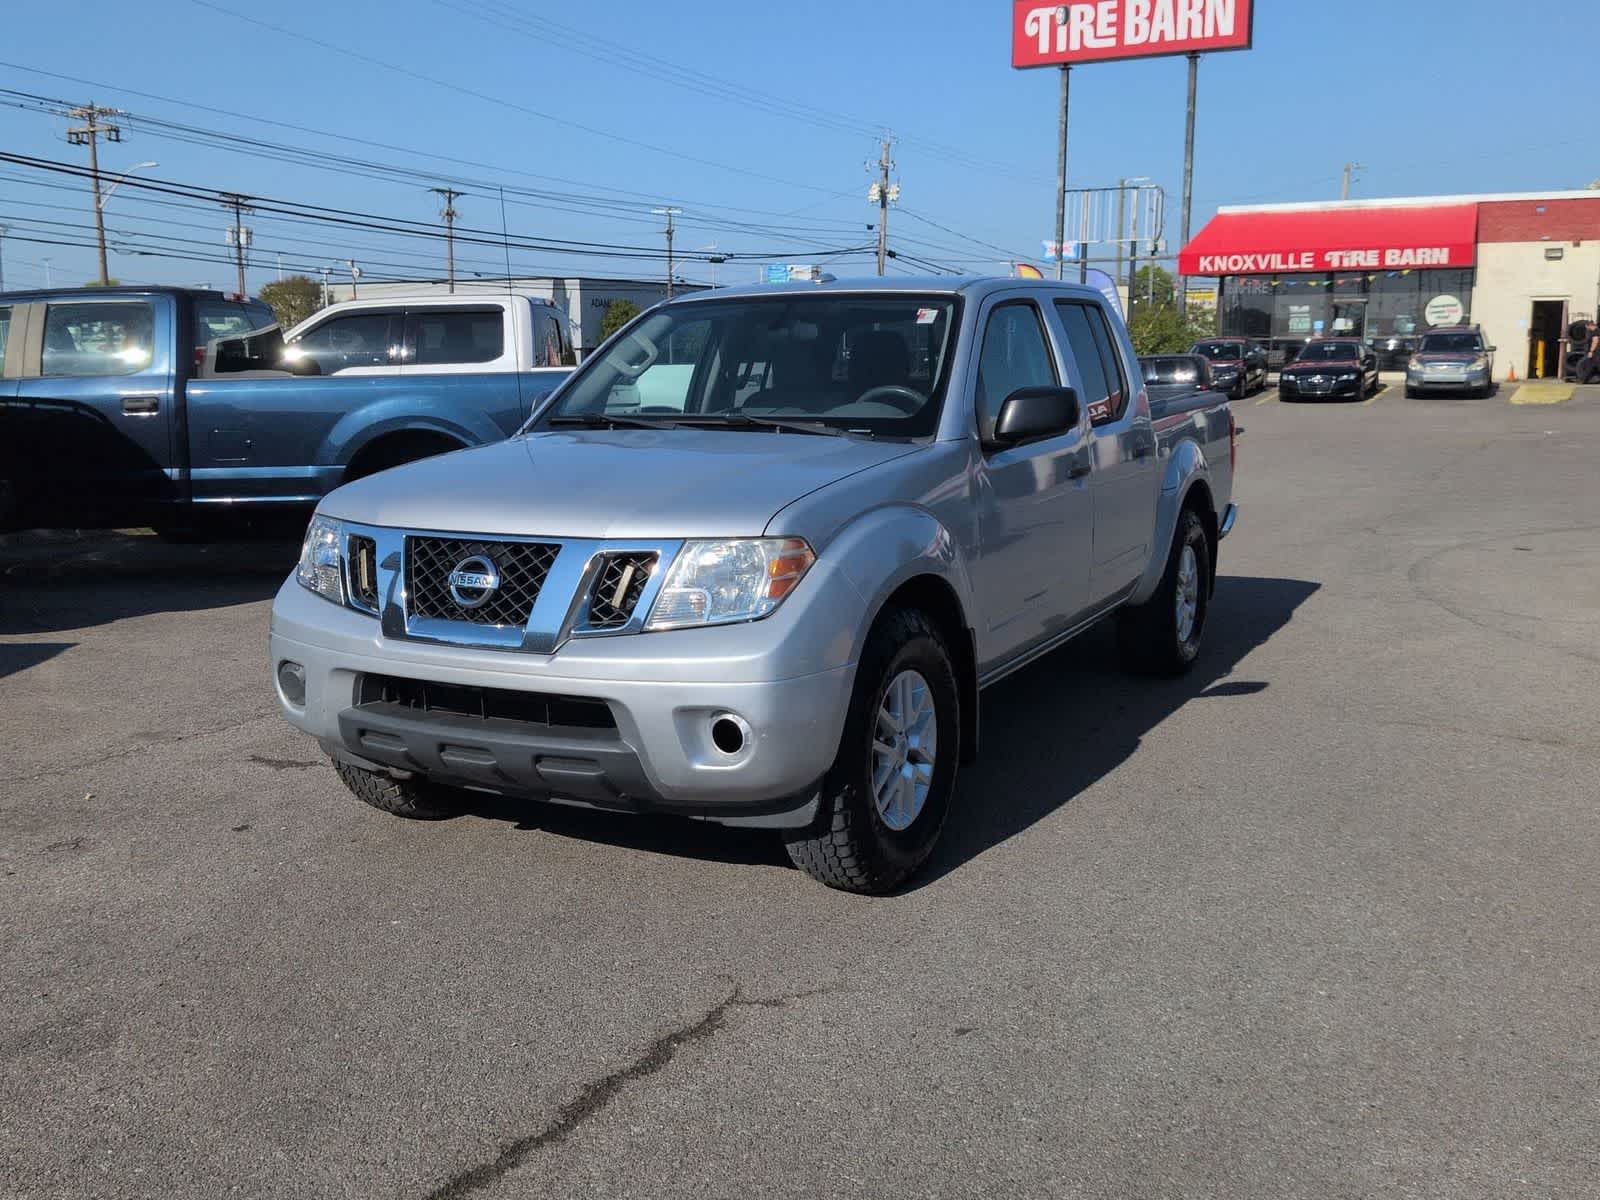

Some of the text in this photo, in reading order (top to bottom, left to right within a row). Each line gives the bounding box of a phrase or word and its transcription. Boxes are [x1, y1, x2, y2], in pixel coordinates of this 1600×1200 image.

[1123, 0, 1235, 46] BARN
[1199, 252, 1315, 272] KNOXVILLE
[1385, 247, 1450, 266] BARN
[450, 574, 491, 586] NISSAN
